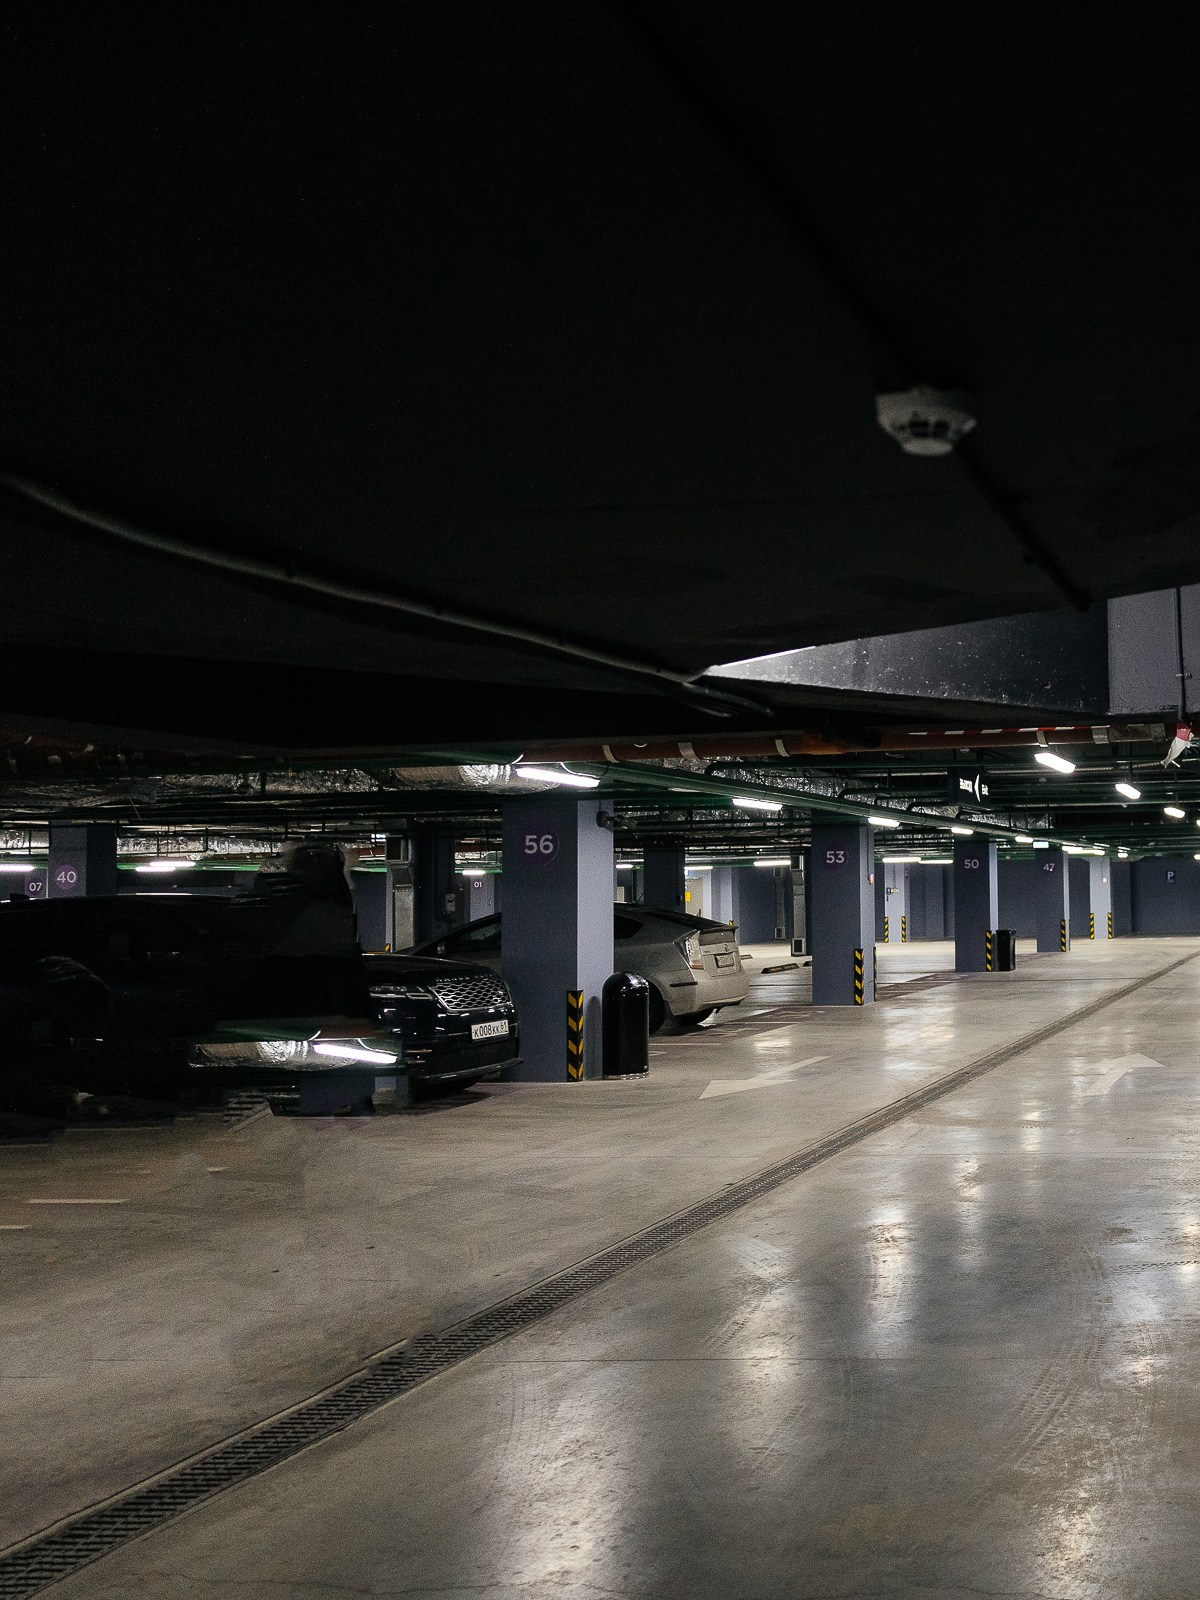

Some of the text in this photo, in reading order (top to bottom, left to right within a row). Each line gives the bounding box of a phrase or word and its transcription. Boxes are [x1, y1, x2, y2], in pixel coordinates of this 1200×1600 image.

[525, 834, 554, 854] 56
[826, 850, 845, 864] 53
[964, 859, 979, 869] 50
[56, 871, 77, 883] 40
[1167, 871, 1174, 880] P
[29, 882, 43, 892] 07
